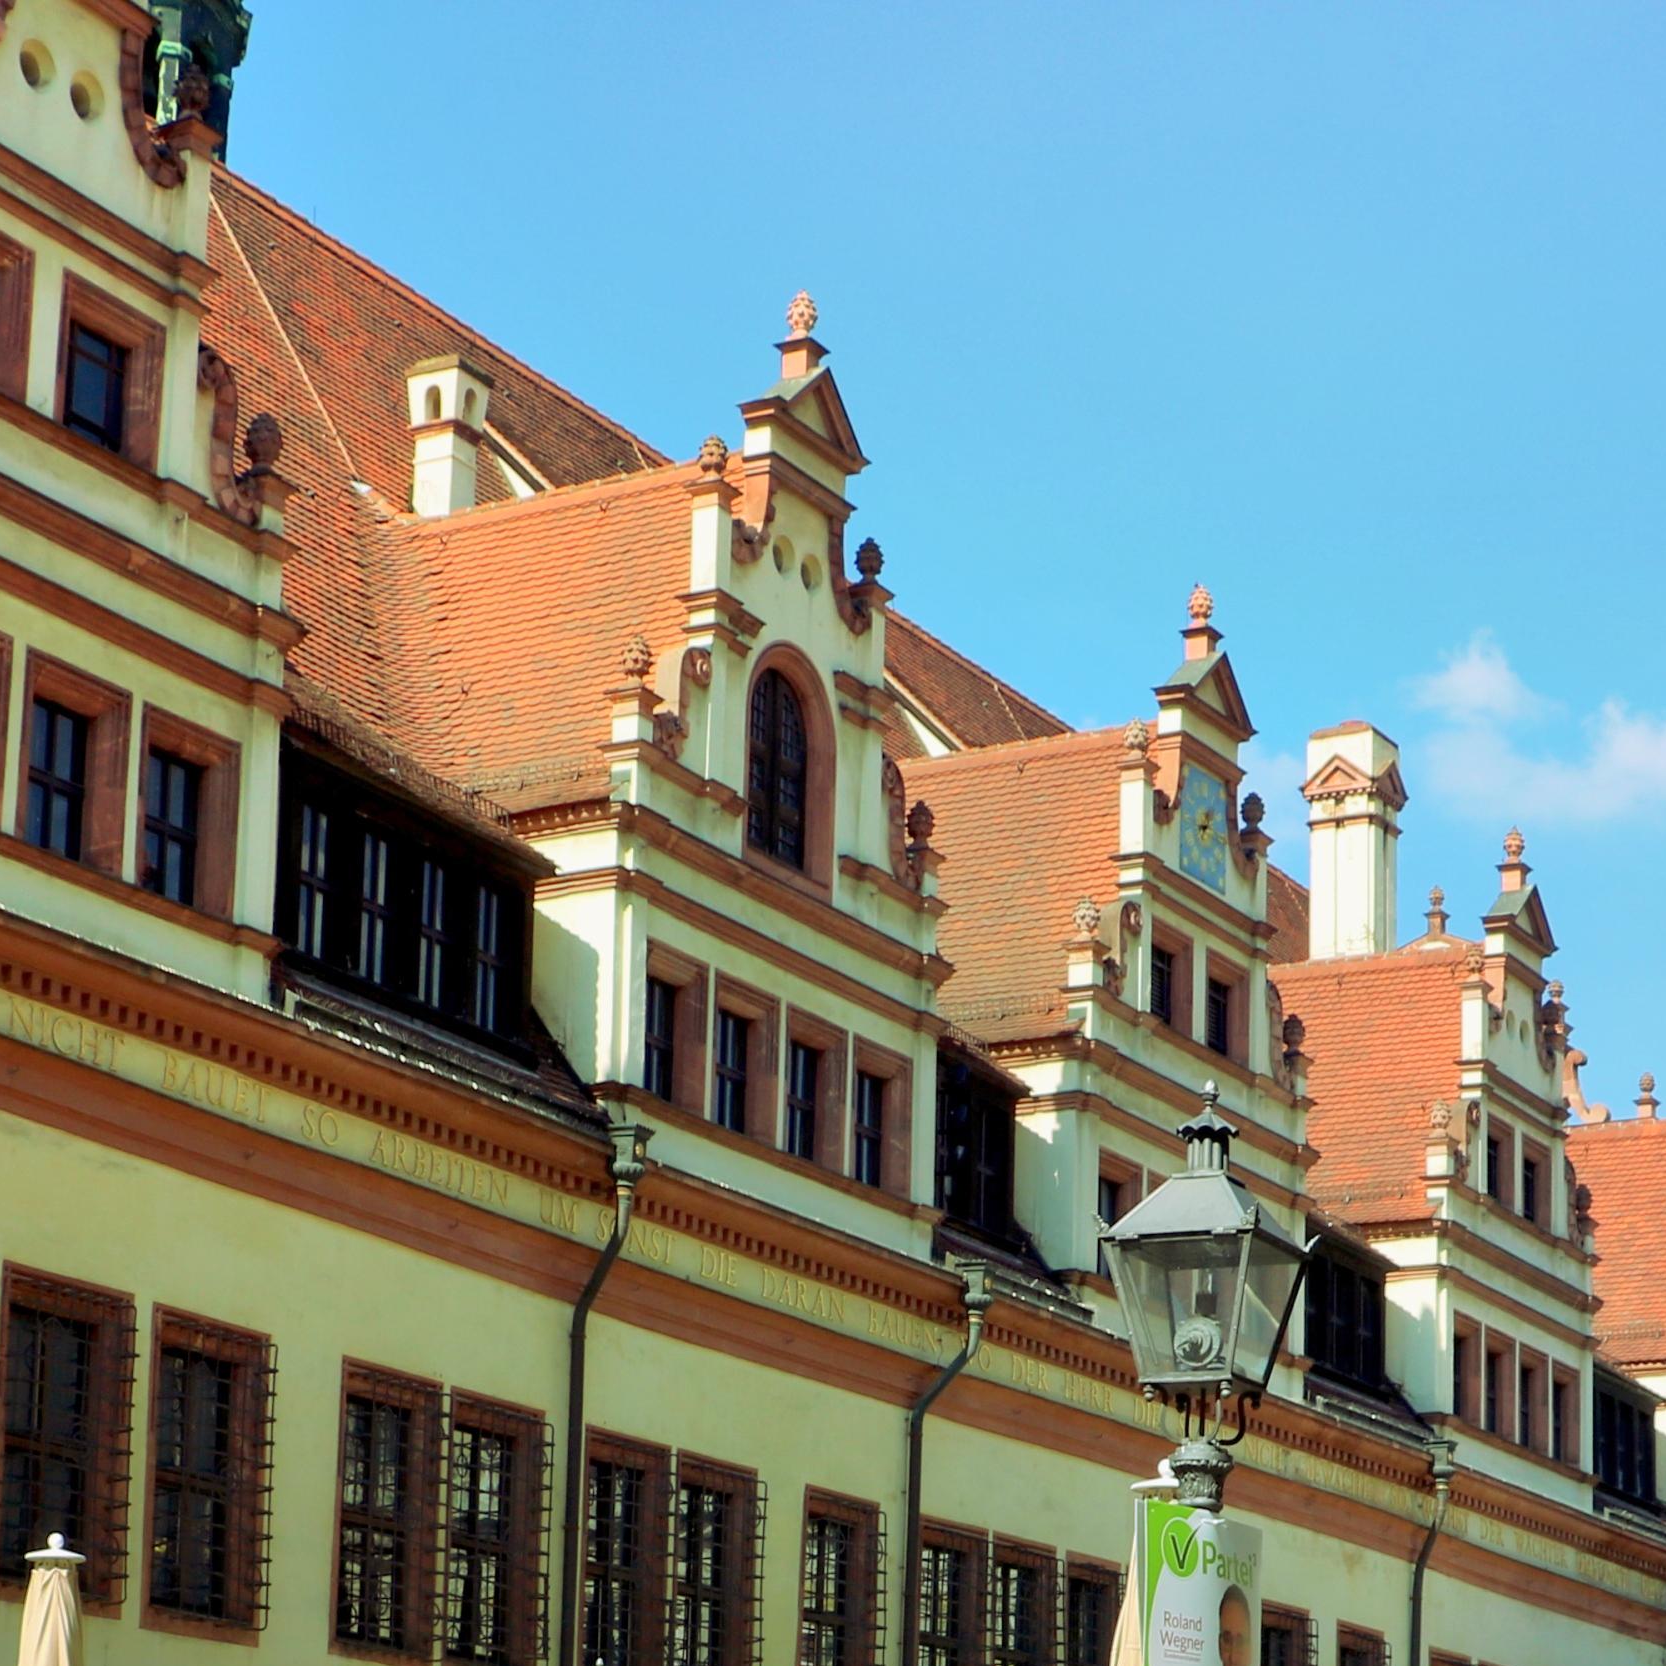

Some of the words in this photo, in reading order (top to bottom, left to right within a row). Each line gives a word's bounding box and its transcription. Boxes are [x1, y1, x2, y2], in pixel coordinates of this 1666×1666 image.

[8, 996, 126, 1073] NICHT
[161, 1050, 270, 1124] BAUET
[300, 1103, 339, 1146] SO
[368, 1130, 512, 1209] ARBEITEN
[536, 1187, 581, 1235] UM
[699, 1245, 740, 1288] DIE
[760, 1266, 848, 1325] DARAN
[868, 1302, 940, 1354] BAUEN
[1011, 1354, 1051, 1393] DER
[1064, 1370, 1116, 1415] HERR
[1163, 1610, 1202, 1632] Roland
[1160, 1630, 1205, 1653] Wegner
